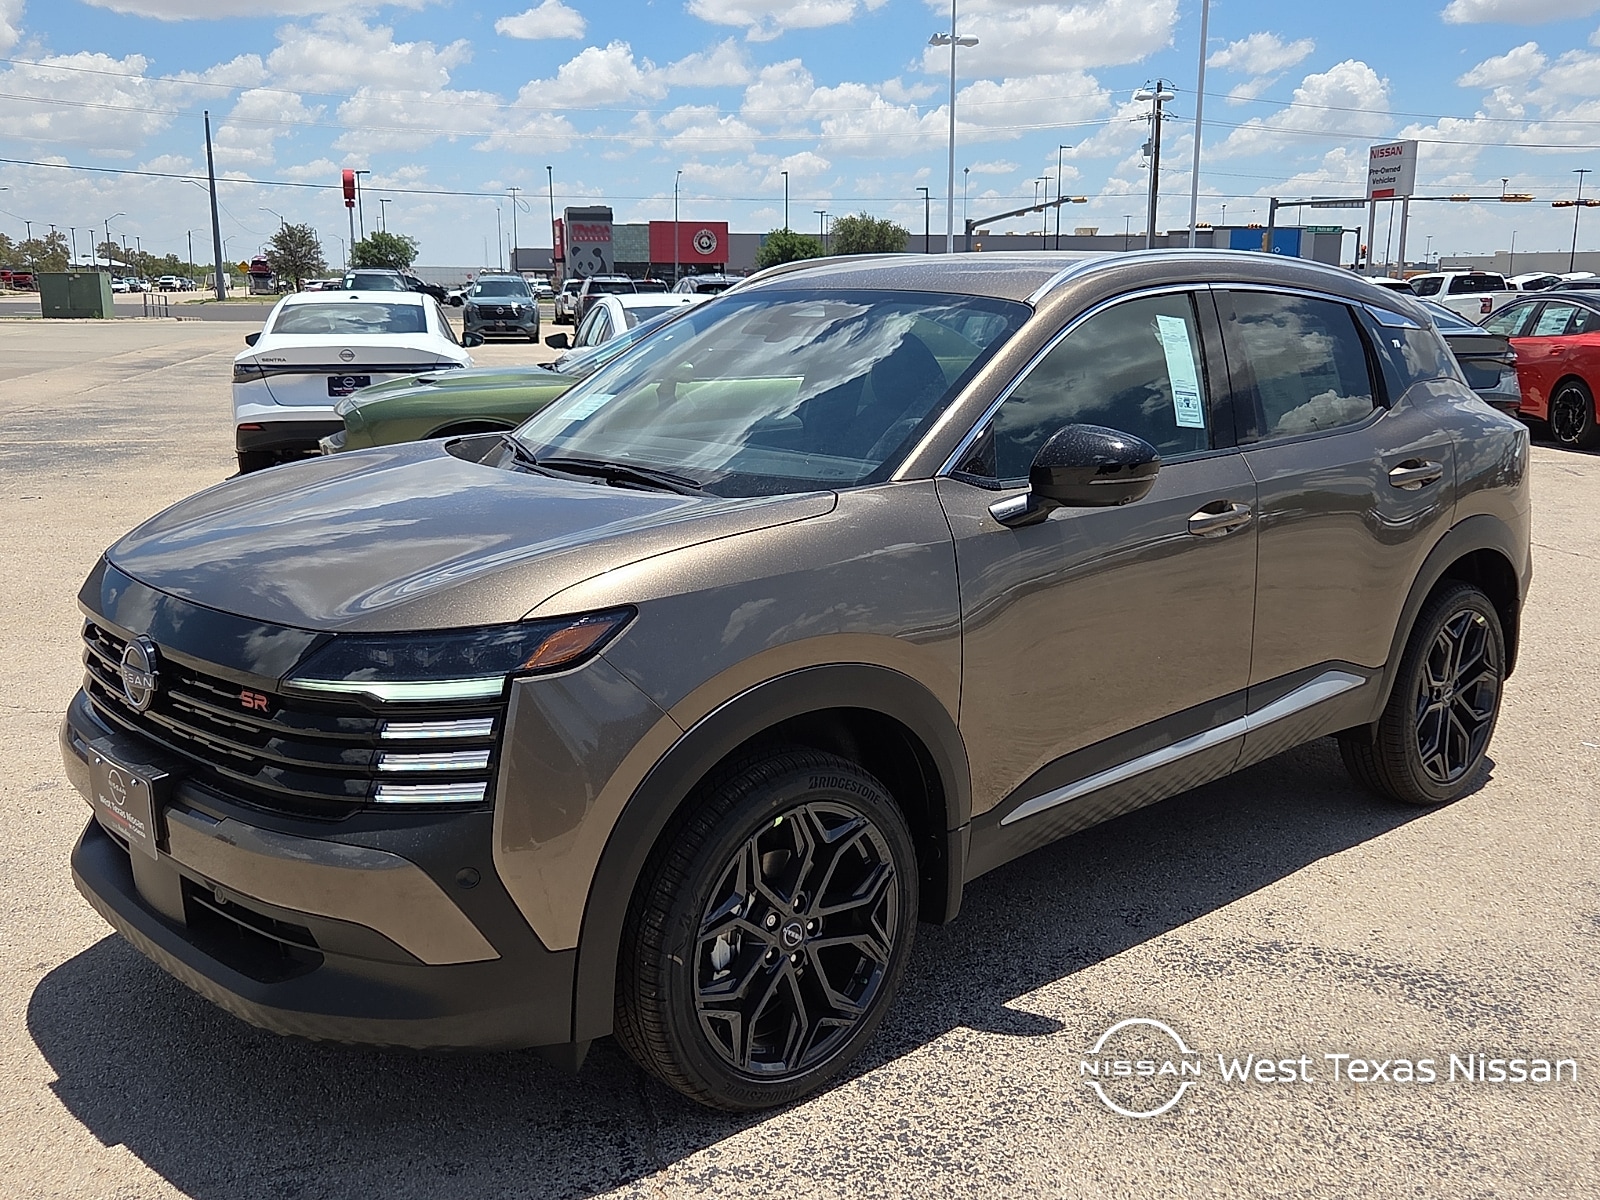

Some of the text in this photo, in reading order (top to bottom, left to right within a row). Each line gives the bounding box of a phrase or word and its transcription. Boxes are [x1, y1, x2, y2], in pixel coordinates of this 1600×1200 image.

[1371, 146, 1403, 159] NISSAN
[1369, 165, 1401, 175] Pre-Owned
[1372, 176, 1396, 185] Vehicles
[240, 690, 268, 712] SR
[808, 776, 881, 805] BRIDGESTONE
